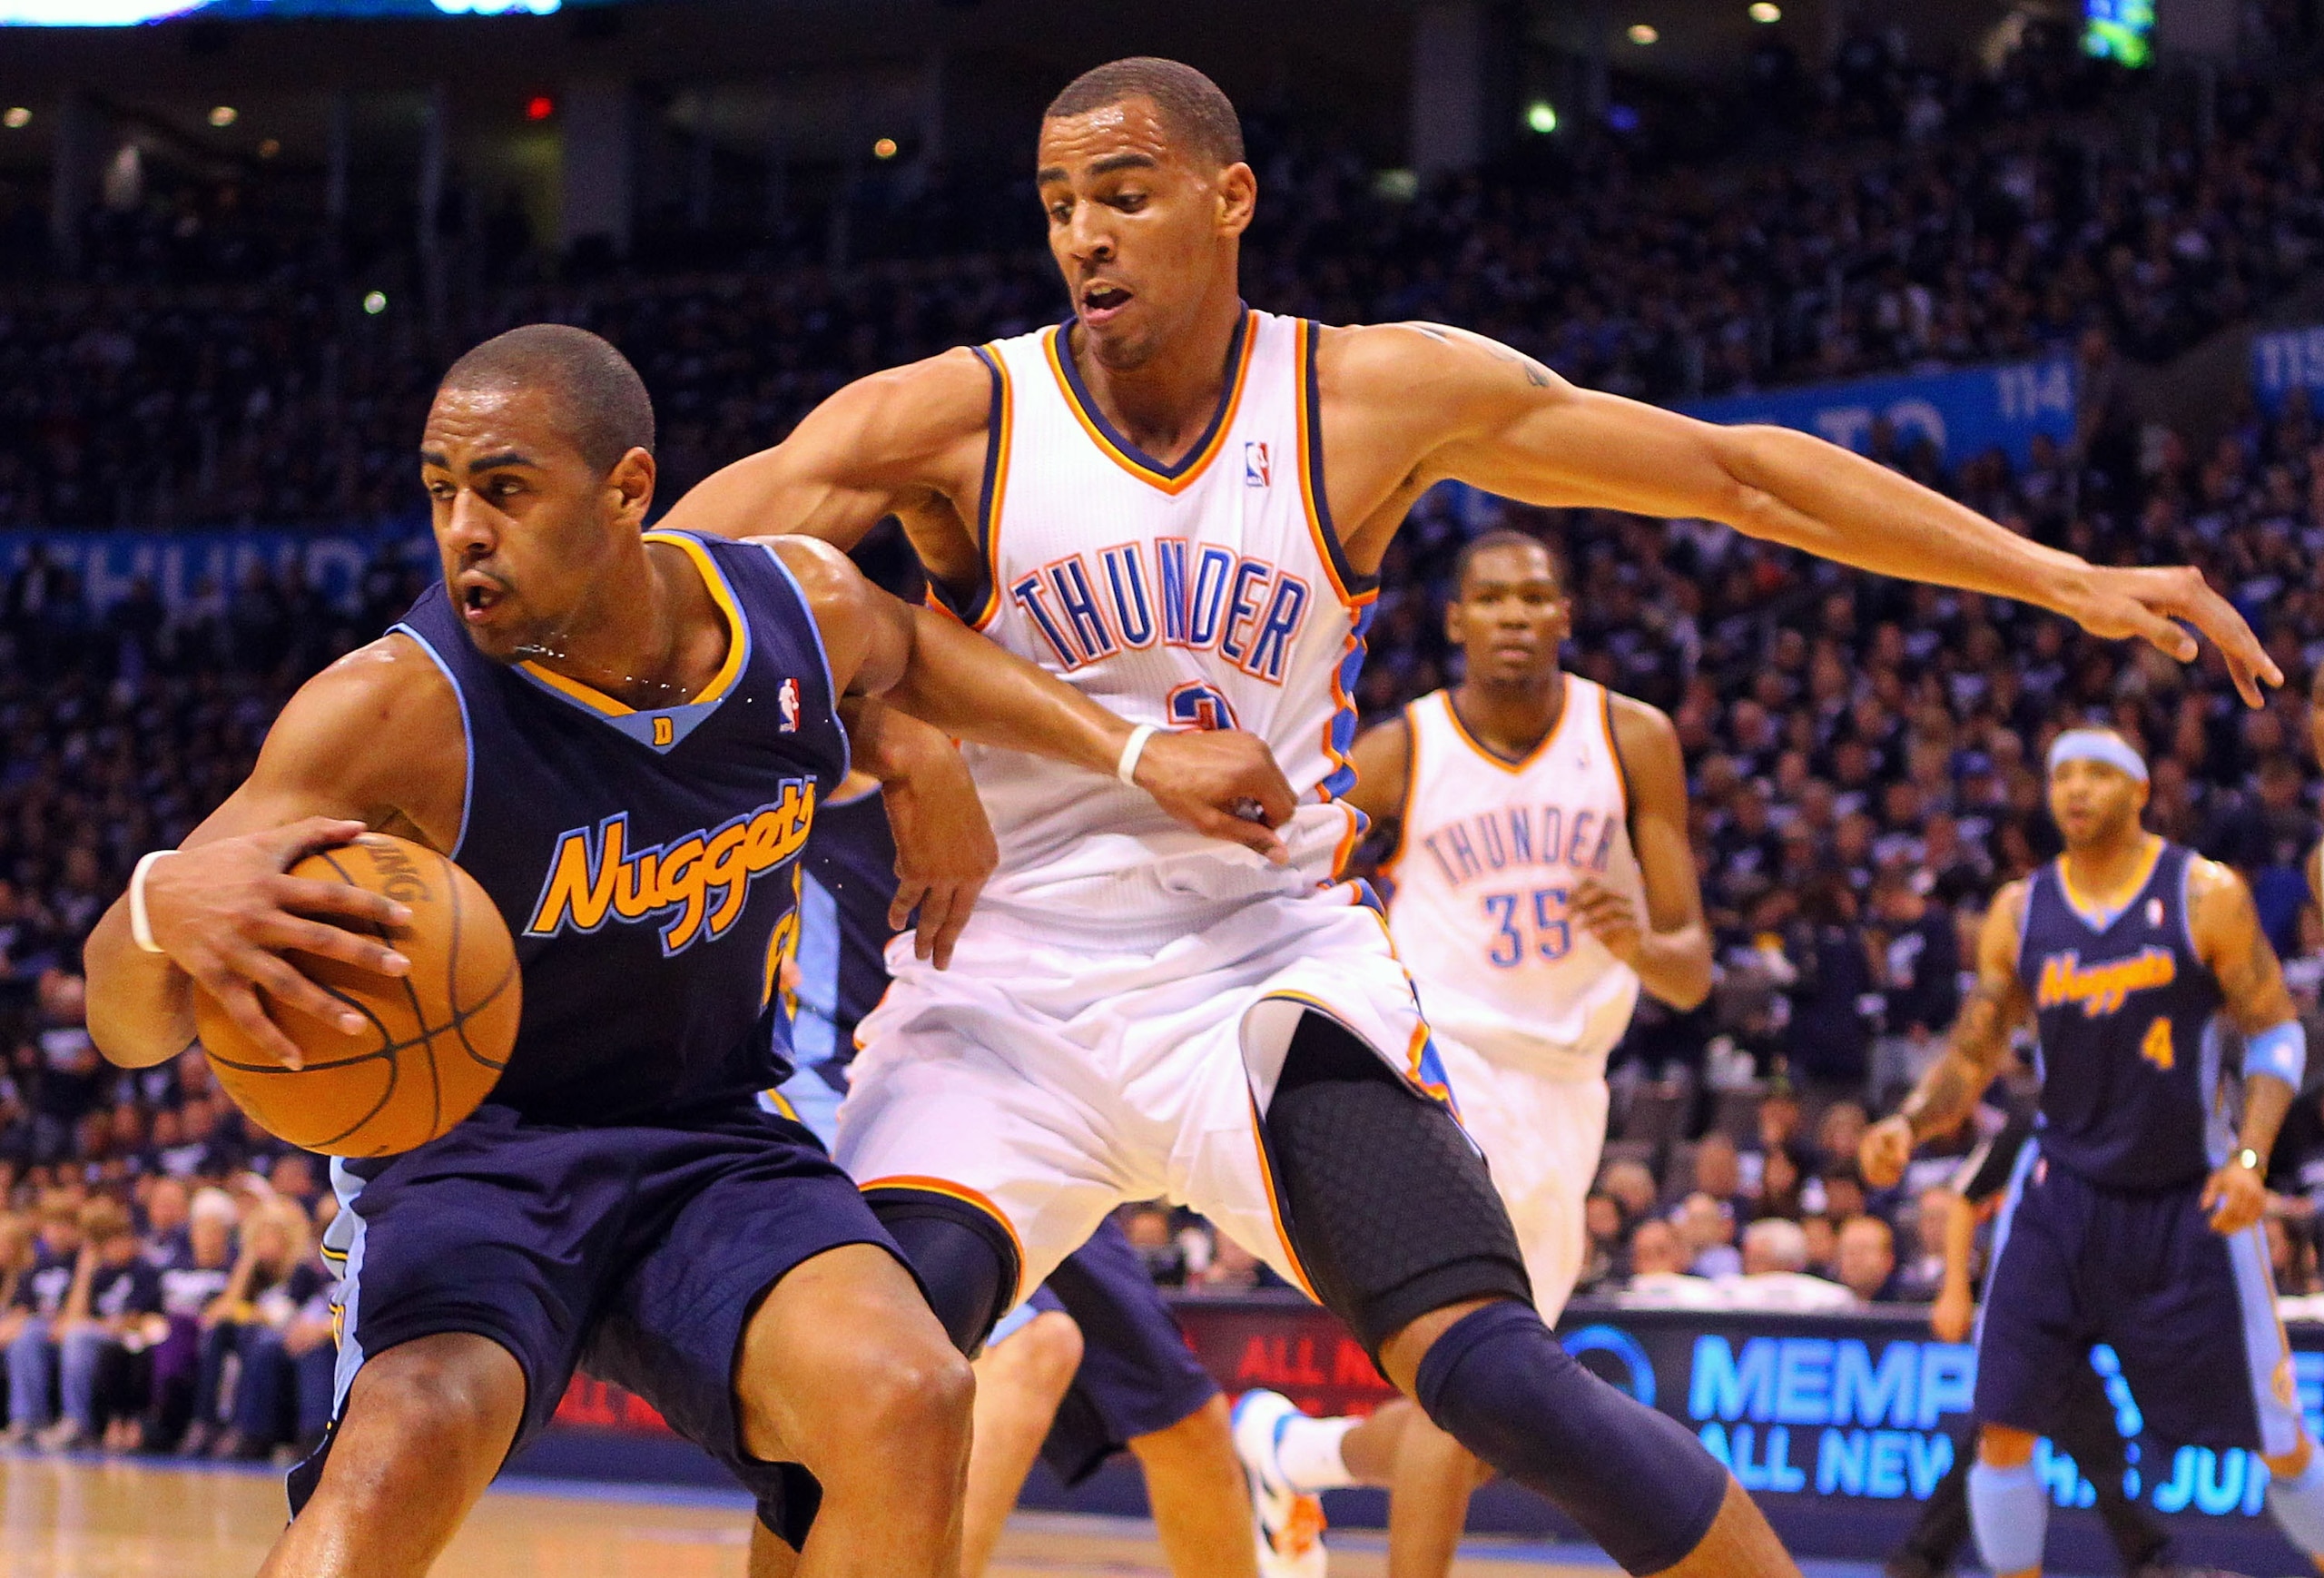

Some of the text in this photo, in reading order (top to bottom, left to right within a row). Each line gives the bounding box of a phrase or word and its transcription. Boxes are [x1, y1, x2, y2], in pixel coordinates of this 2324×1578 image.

[1009, 538, 1312, 687] THUNDER
[652, 716, 675, 746] D
[522, 774, 817, 959] Nuggets
[1482, 885, 1574, 970] 35
[2140, 1014, 2176, 1071] 4
[1688, 1334, 1979, 1430] MEMP
